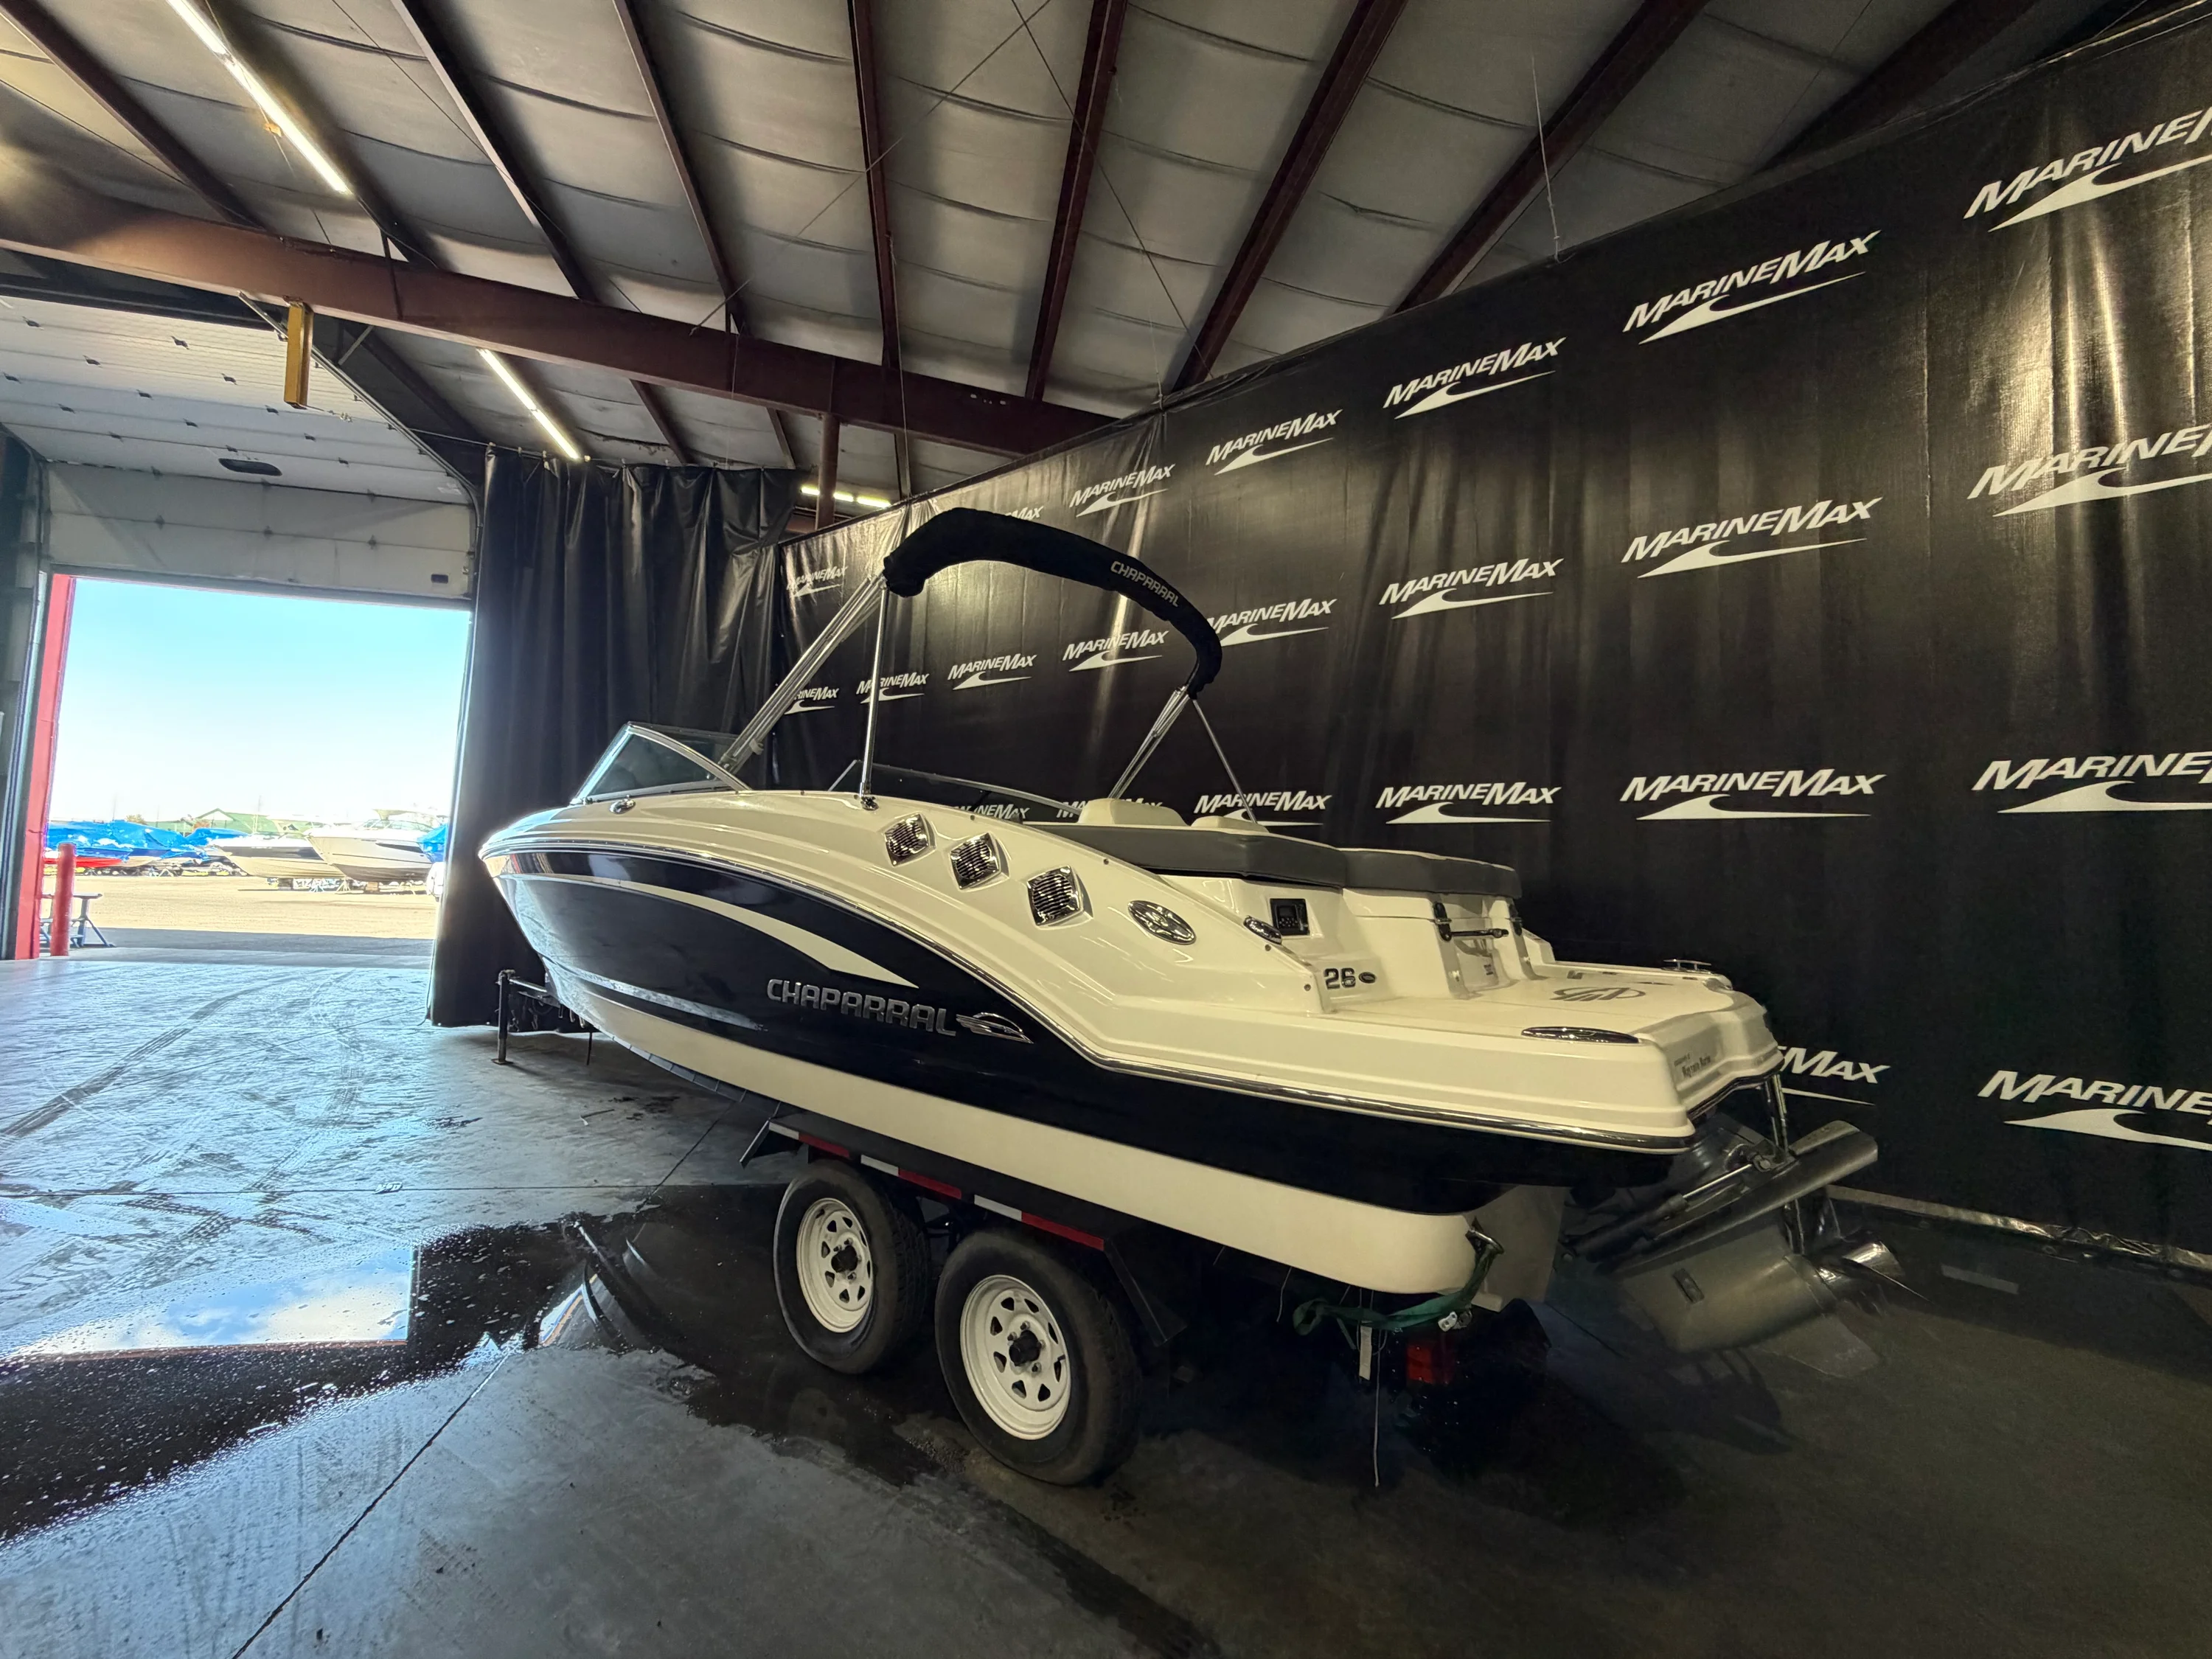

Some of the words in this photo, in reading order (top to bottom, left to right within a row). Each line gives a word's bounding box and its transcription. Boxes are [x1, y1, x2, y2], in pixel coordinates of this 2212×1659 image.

[1623, 230, 1881, 332] MARINEMAX
[1382, 337, 1566, 408] MARINEMAX
[1206, 409, 1342, 465] MARINEMAX
[1967, 423, 2212, 499] MARINE
[1621, 497, 1882, 563] MARINEMAX
[1110, 560, 1180, 608] CHAPARRAL
[1379, 558, 1563, 605] MARINEMAX
[947, 653, 1037, 680] MARINEMAX
[1376, 782, 1562, 809] MARINEMAX
[1620, 768, 1887, 801] MARINEMAX
[1972, 751, 2212, 791] MARINE
[767, 978, 957, 1037] CHAPARRAL
[1978, 1071, 2212, 1125] MARINE
